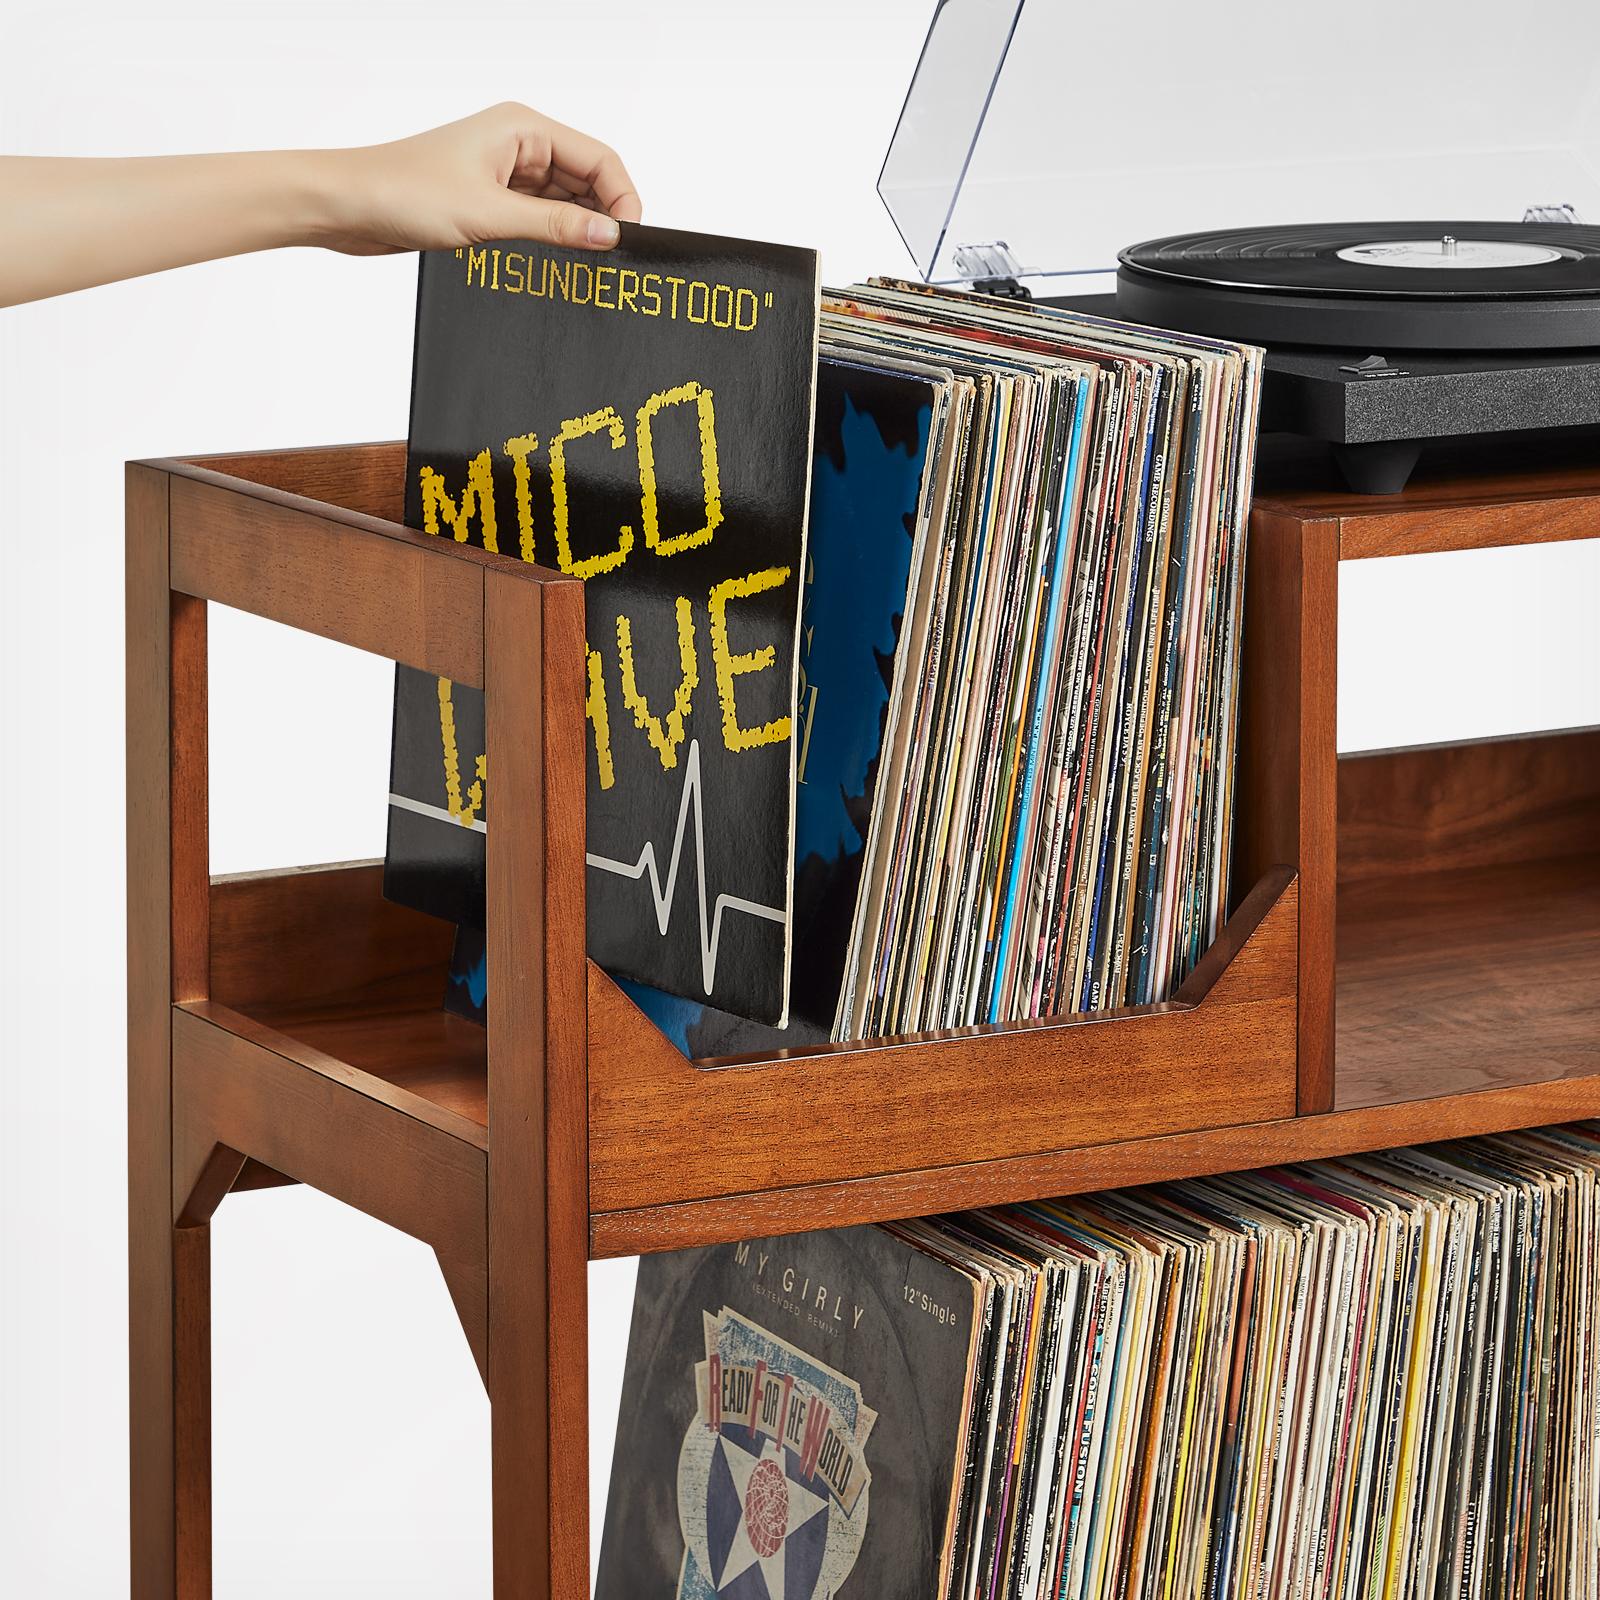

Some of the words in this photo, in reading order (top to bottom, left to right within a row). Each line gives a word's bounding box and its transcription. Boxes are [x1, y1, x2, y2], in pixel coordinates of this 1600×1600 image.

[456, 247, 773, 331] "MISUNDERSTOOD"
[1110, 387, 1120, 412] MUSIC
[1107, 412, 1117, 441] BANDAI
[420, 381, 724, 580] MICO
[1152, 453, 1163, 482] GAME
[1146, 484, 1159, 543] RECORDINGS
[1161, 496, 1170, 533] RAWKUS
[1090, 697, 1101, 737] GERONIMO
[1123, 701, 1133, 736] ROYCE
[1085, 737, 1097, 777] WHEREVER
[1121, 735, 1130, 749] DA
[1134, 738, 1144, 761] STAR
[1131, 761, 1142, 790] BLACK
[1085, 825, 1093, 837] the
[1124, 843, 1134, 860] DEF
[1122, 860, 1132, 880] MOS
[735, 1241, 770, 1274] MY
[782, 1267, 865, 1330] GIRLY
[1297, 1274, 1306, 1297] TOMMY
[921, 1294, 956, 1326] Single
[709, 1353, 753, 1433] READY
[748, 1359, 780, 1440] FOR
[776, 1373, 806, 1453] THE
[800, 1394, 853, 1498] WORLD
[1074, 1420, 1095, 1493] FUSION
[1465, 1510, 1475, 1535] PARTY
[1318, 1527, 1327, 1550] BLACK
[1461, 1539, 1473, 1574] GANGSTA
